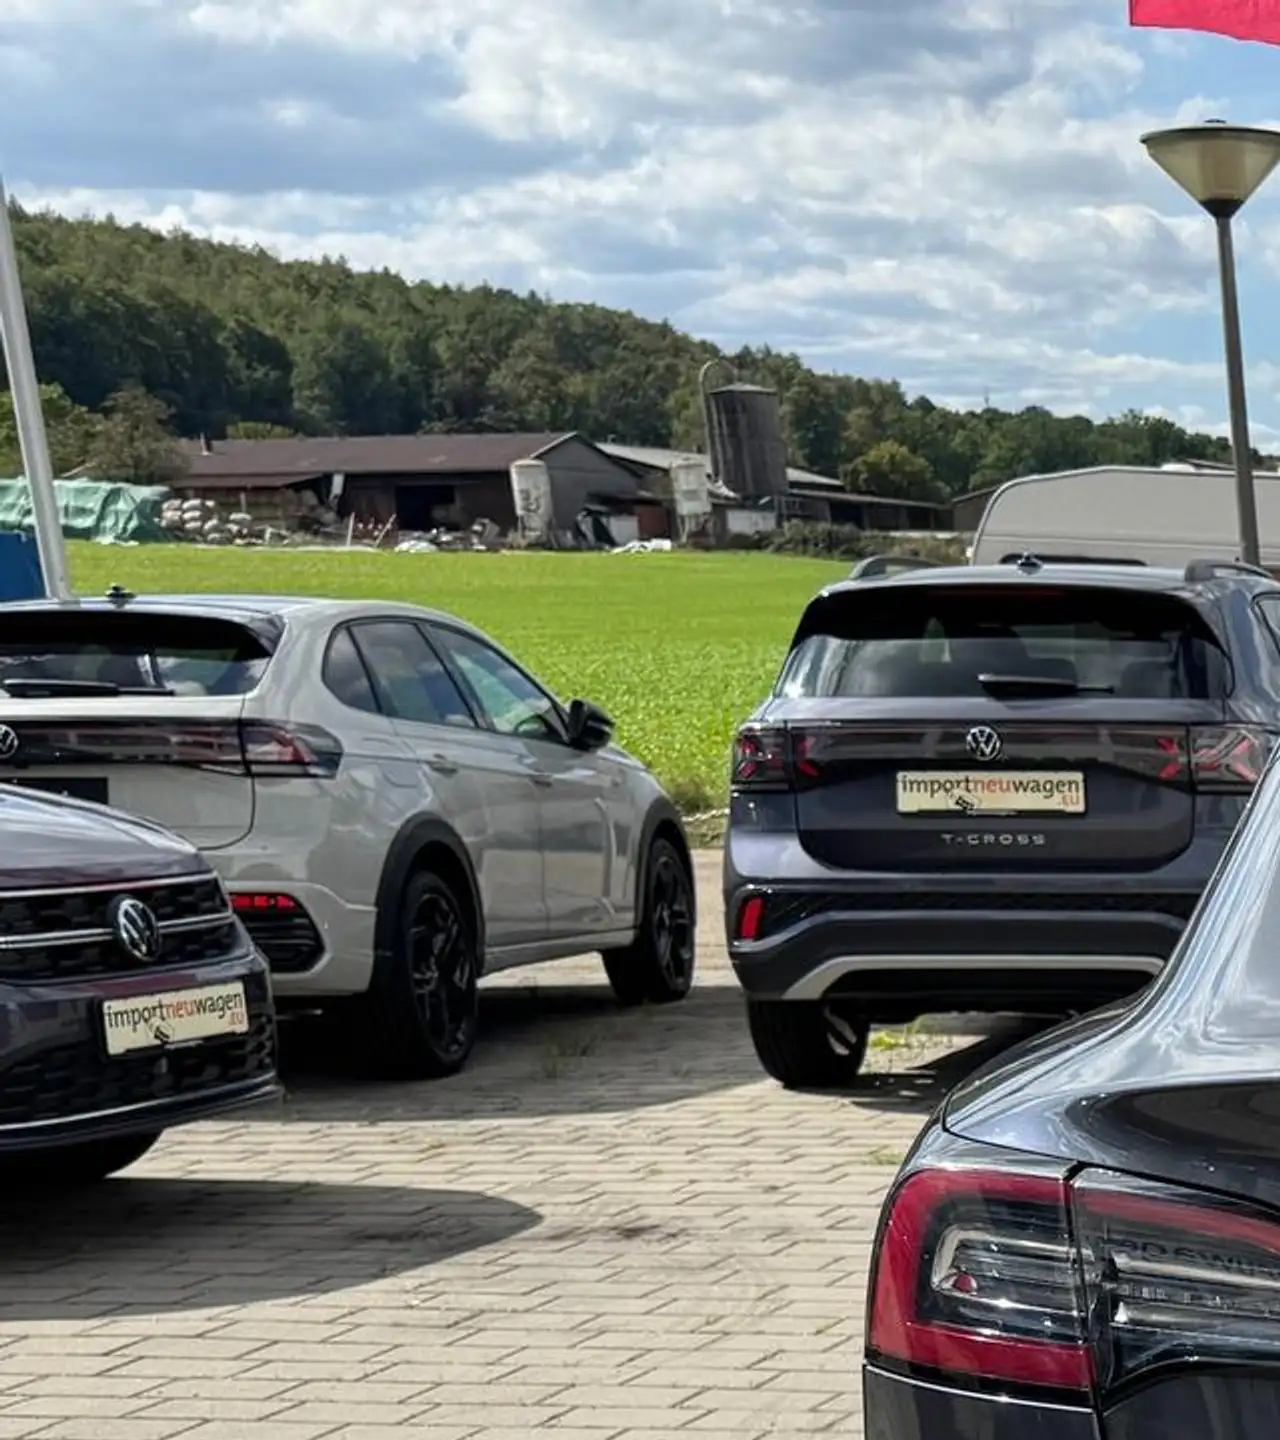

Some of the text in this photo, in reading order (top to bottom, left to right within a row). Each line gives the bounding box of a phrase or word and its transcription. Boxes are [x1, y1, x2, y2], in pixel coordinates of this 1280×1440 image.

[902, 774, 1080, 799] importneuwagen
[941, 833, 1046, 845] T-CROSS
[106, 992, 243, 1032] importneuwagen
